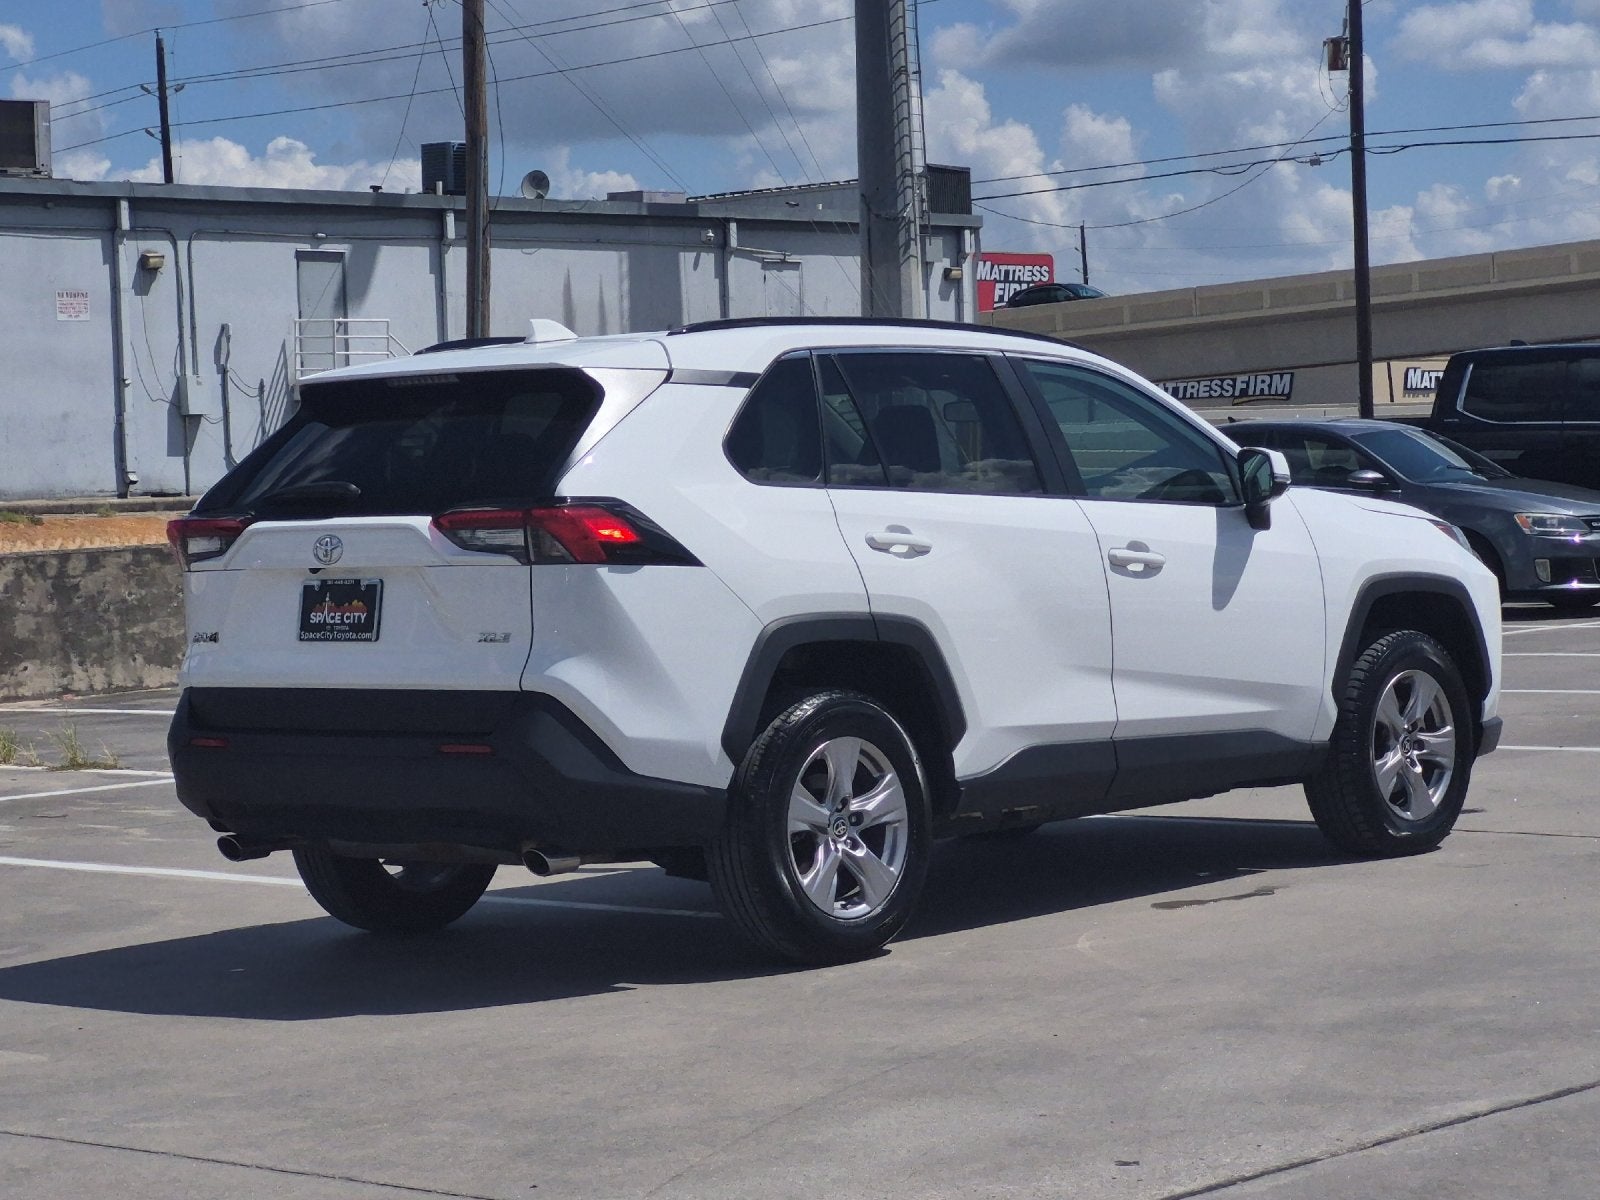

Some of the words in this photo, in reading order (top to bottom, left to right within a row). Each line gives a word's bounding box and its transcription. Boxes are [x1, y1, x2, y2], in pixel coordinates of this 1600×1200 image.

[976, 261, 1049, 282] MATTRESS
[310, 612, 341, 624] SPACE
[343, 612, 367, 624] CITY
[300, 631, 372, 640] SpaceCityToyota.com
